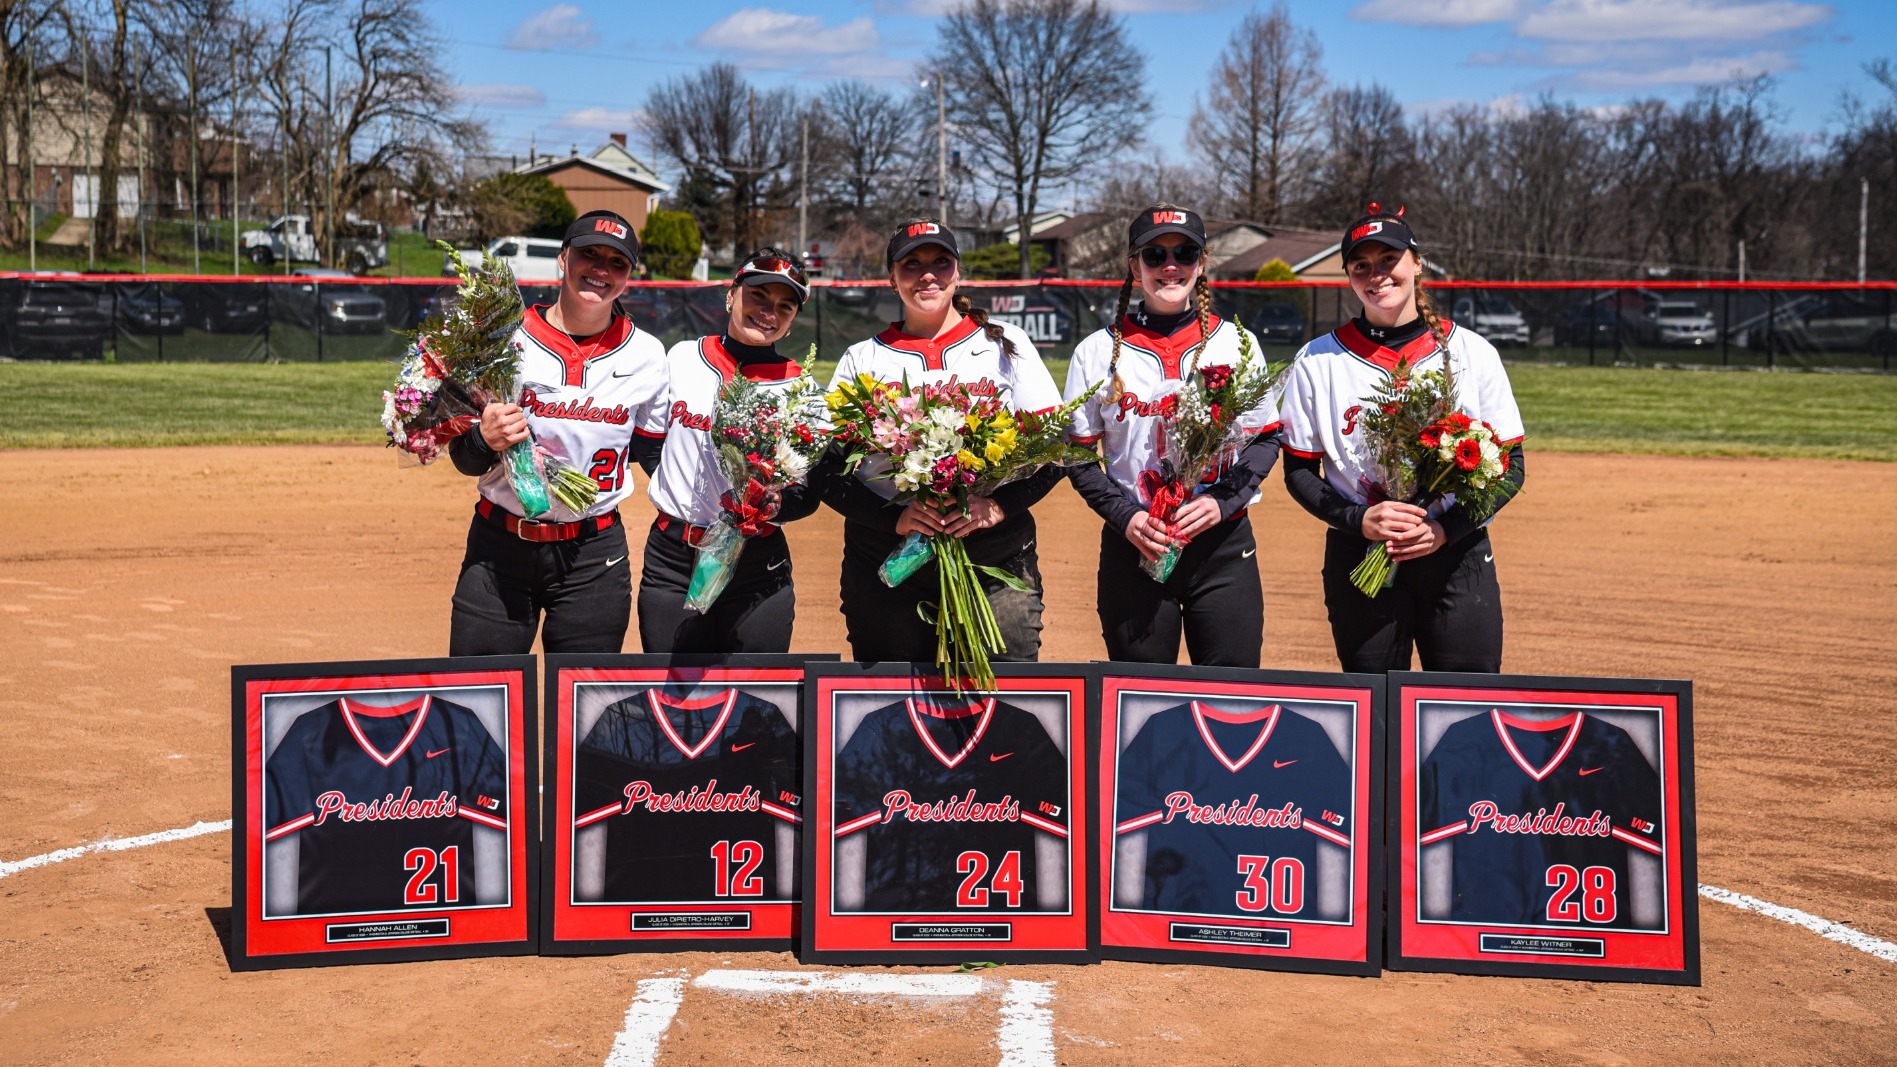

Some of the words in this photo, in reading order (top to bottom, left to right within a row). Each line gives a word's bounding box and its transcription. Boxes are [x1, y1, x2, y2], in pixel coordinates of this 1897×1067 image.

[519, 388, 630, 425] Presidents
[313, 786, 458, 826] Presidents
[621, 779, 761, 815] Presidents
[881, 789, 1020, 824] Presidents
[1161, 790, 1302, 829] Presidents
[1465, 800, 1612, 837] Presidents
[403, 845, 459, 905] 21
[710, 840, 764, 896] 12
[956, 850, 1023, 907] 24
[1235, 854, 1305, 914] 30
[1545, 864, 1616, 923] 28
[358, 925, 392, 933] HANNAH
[1198, 928, 1228, 936] ASHLEY
[1229, 930, 1262, 938] THEIMER
[1510, 939, 1540, 947] KAYLEE
[1540, 940, 1572, 948] WITNER
